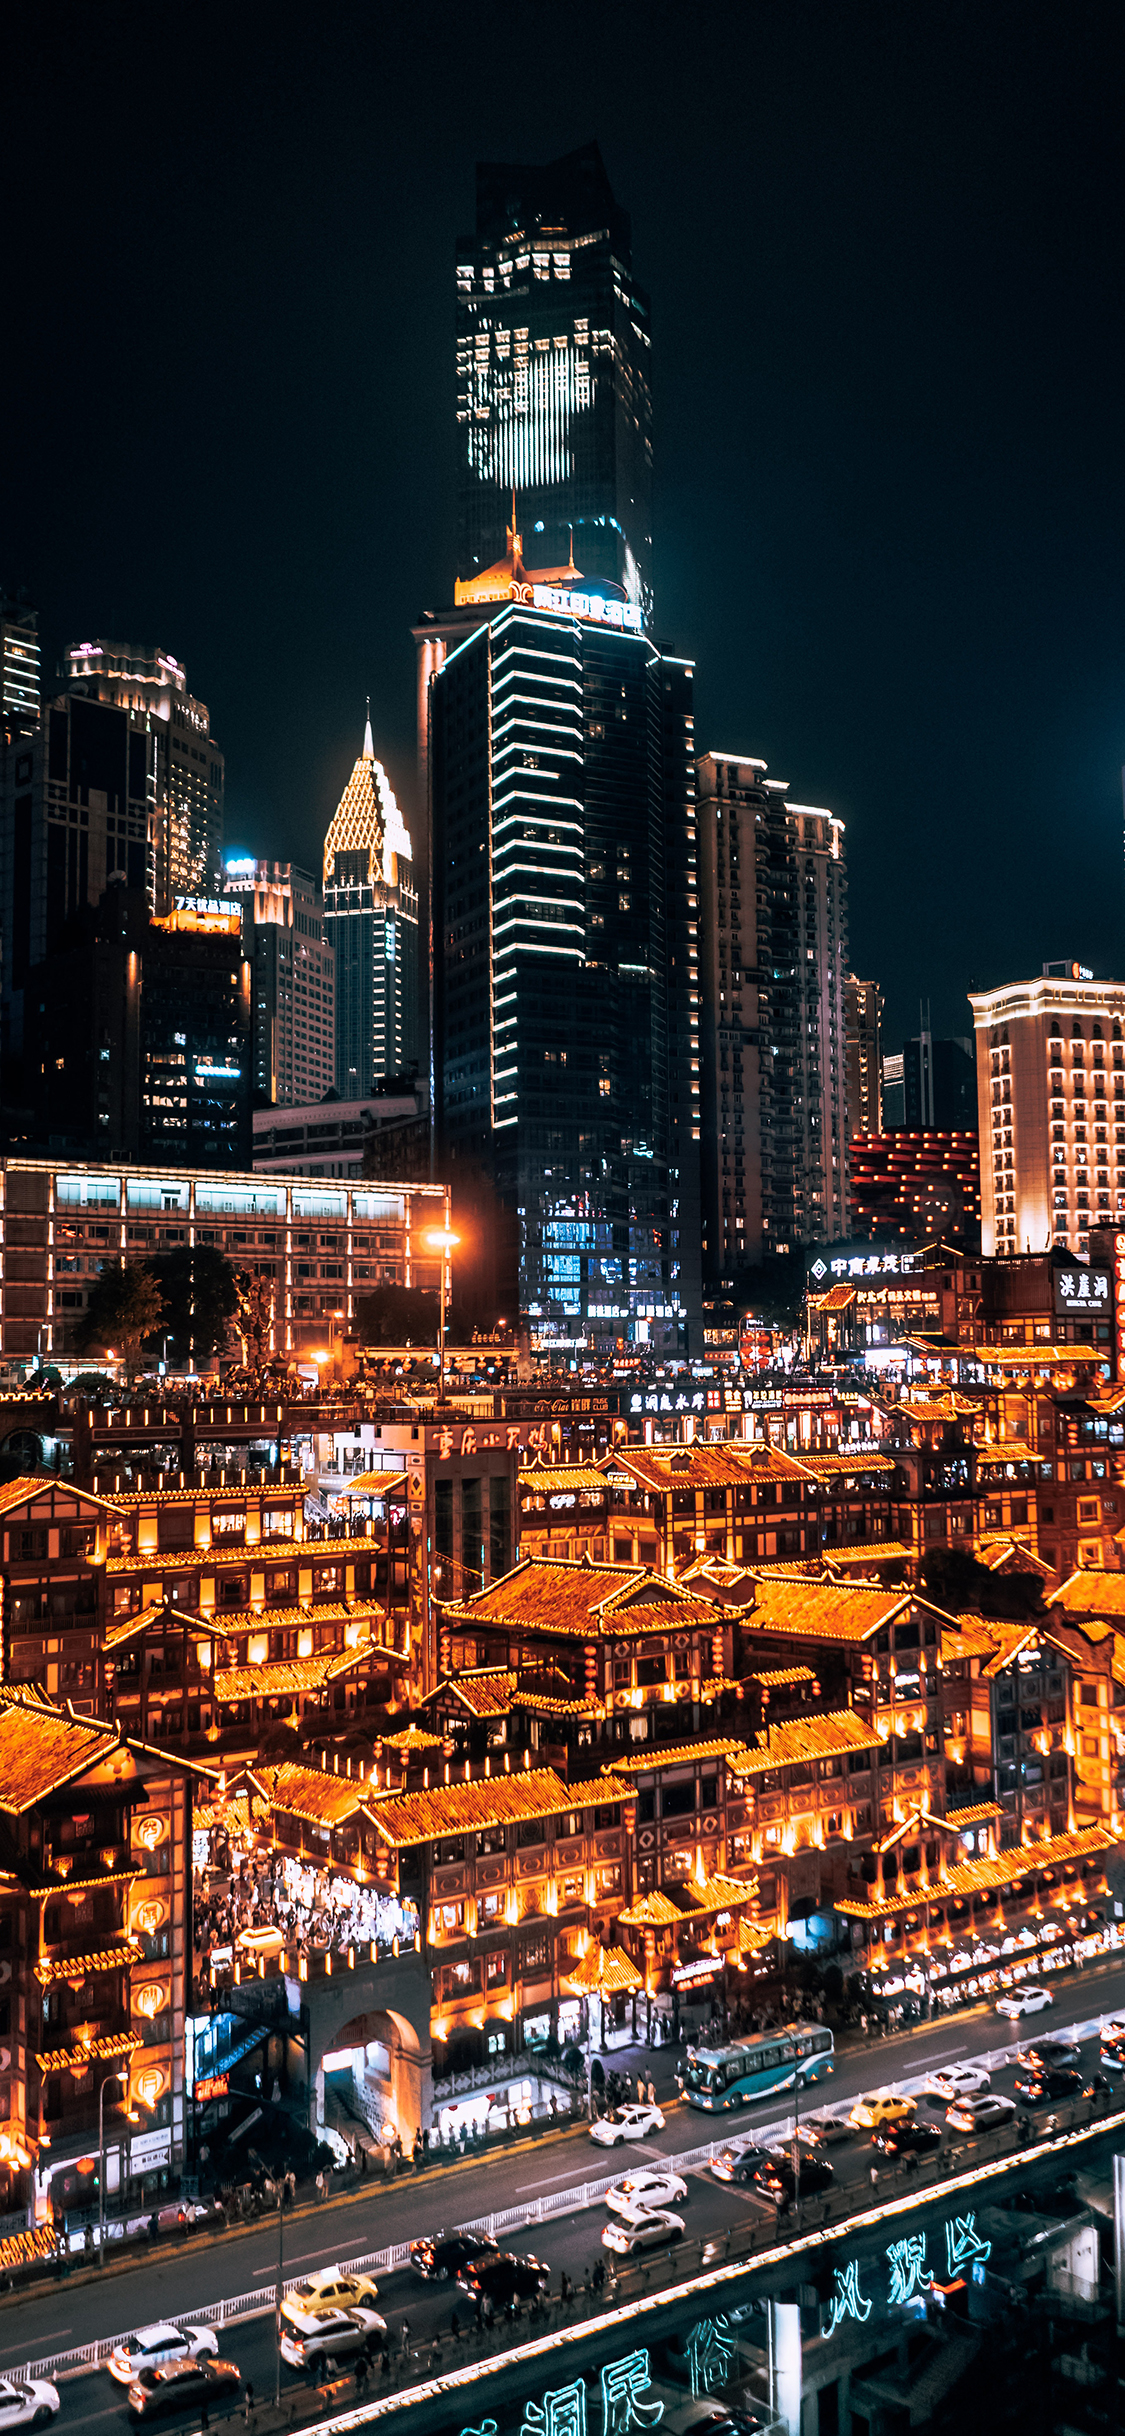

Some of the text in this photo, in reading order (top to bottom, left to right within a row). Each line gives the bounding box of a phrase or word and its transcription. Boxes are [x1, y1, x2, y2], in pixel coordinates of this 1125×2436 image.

[174, 895, 242, 917] 7天优品酒店
[1059, 1272, 1108, 1299] 洪崖洞
